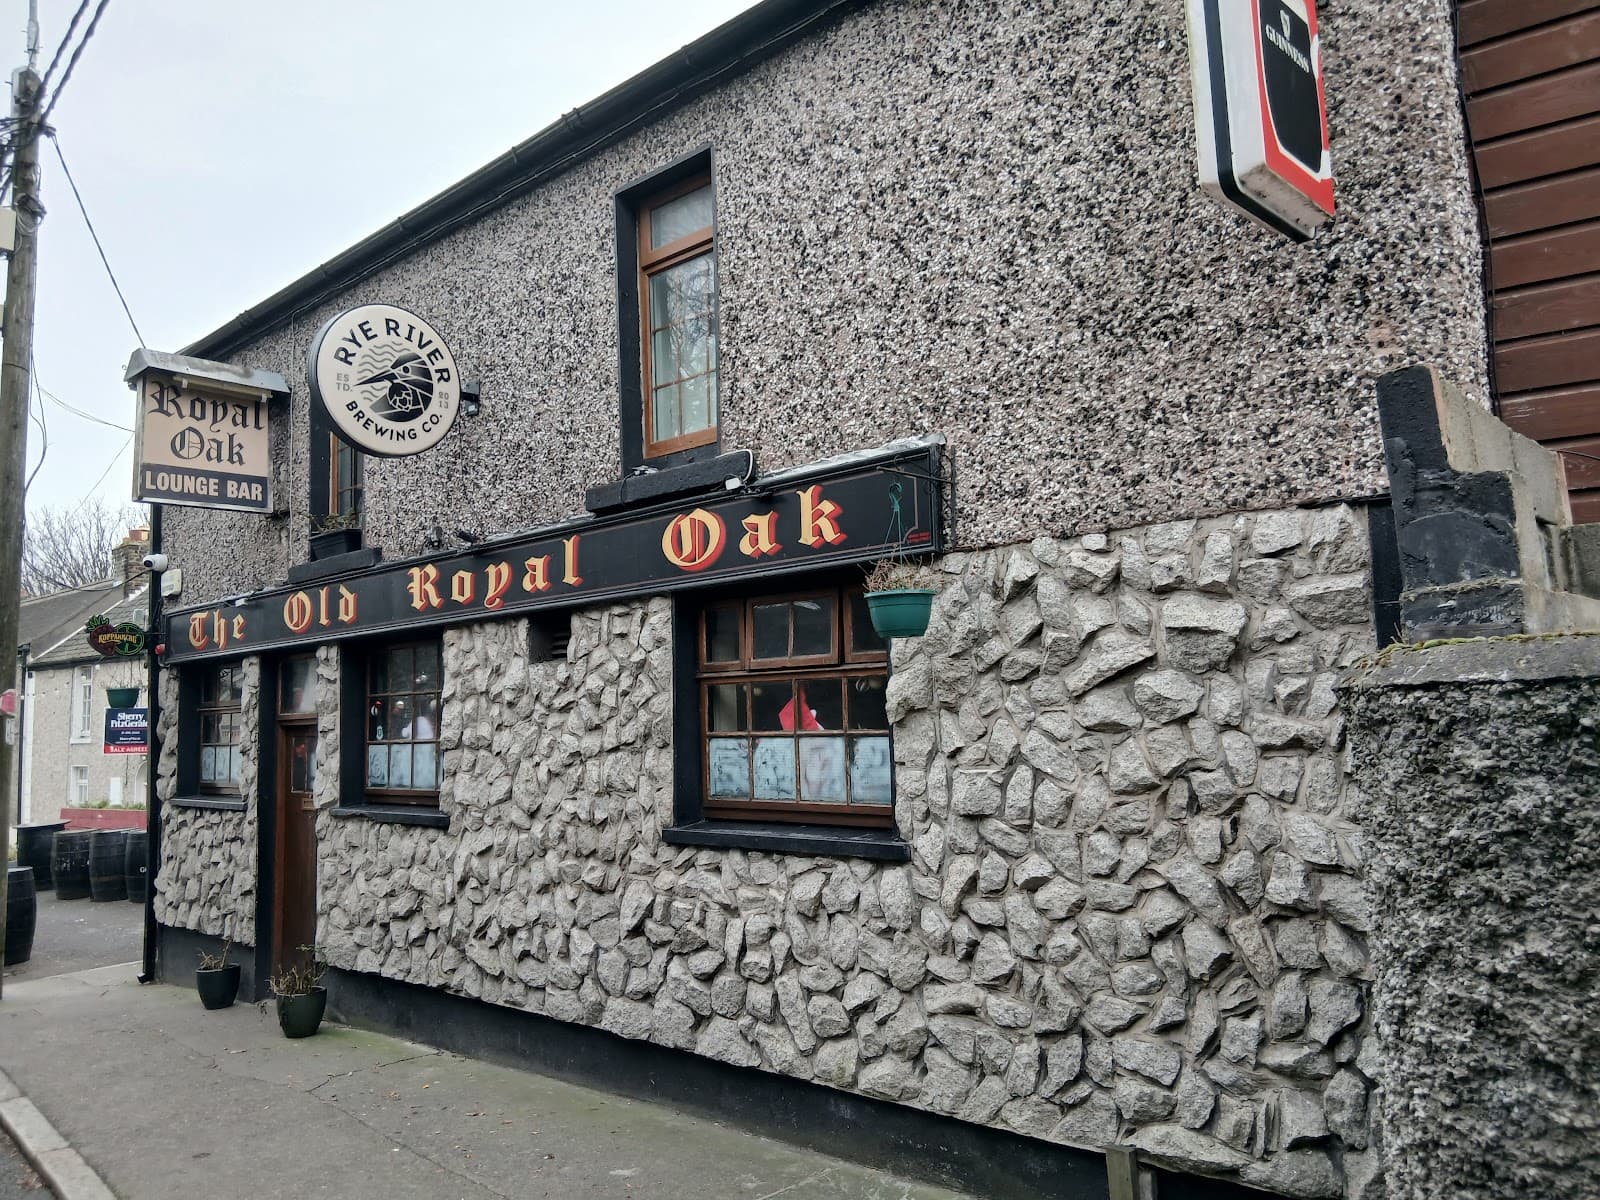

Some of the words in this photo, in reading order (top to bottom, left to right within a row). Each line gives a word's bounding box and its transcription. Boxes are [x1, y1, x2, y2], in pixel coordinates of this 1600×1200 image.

[1265, 23, 1310, 74] GUINNESS
[333, 320, 379, 367] RYE
[385, 317, 451, 384] RIVER
[147, 380, 265, 433] Royal
[345, 400, 418, 442] BREWING
[422, 413, 443, 433] CO.
[170, 426, 246, 467] Oak
[145, 470, 219, 497] LOUNGE
[226, 479, 263, 501] BAR
[188, 608, 247, 652] The
[283, 583, 358, 635] Old
[406, 534, 584, 612] Royal
[661, 484, 848, 573] Oak
[117, 712, 144, 722] Sherry
